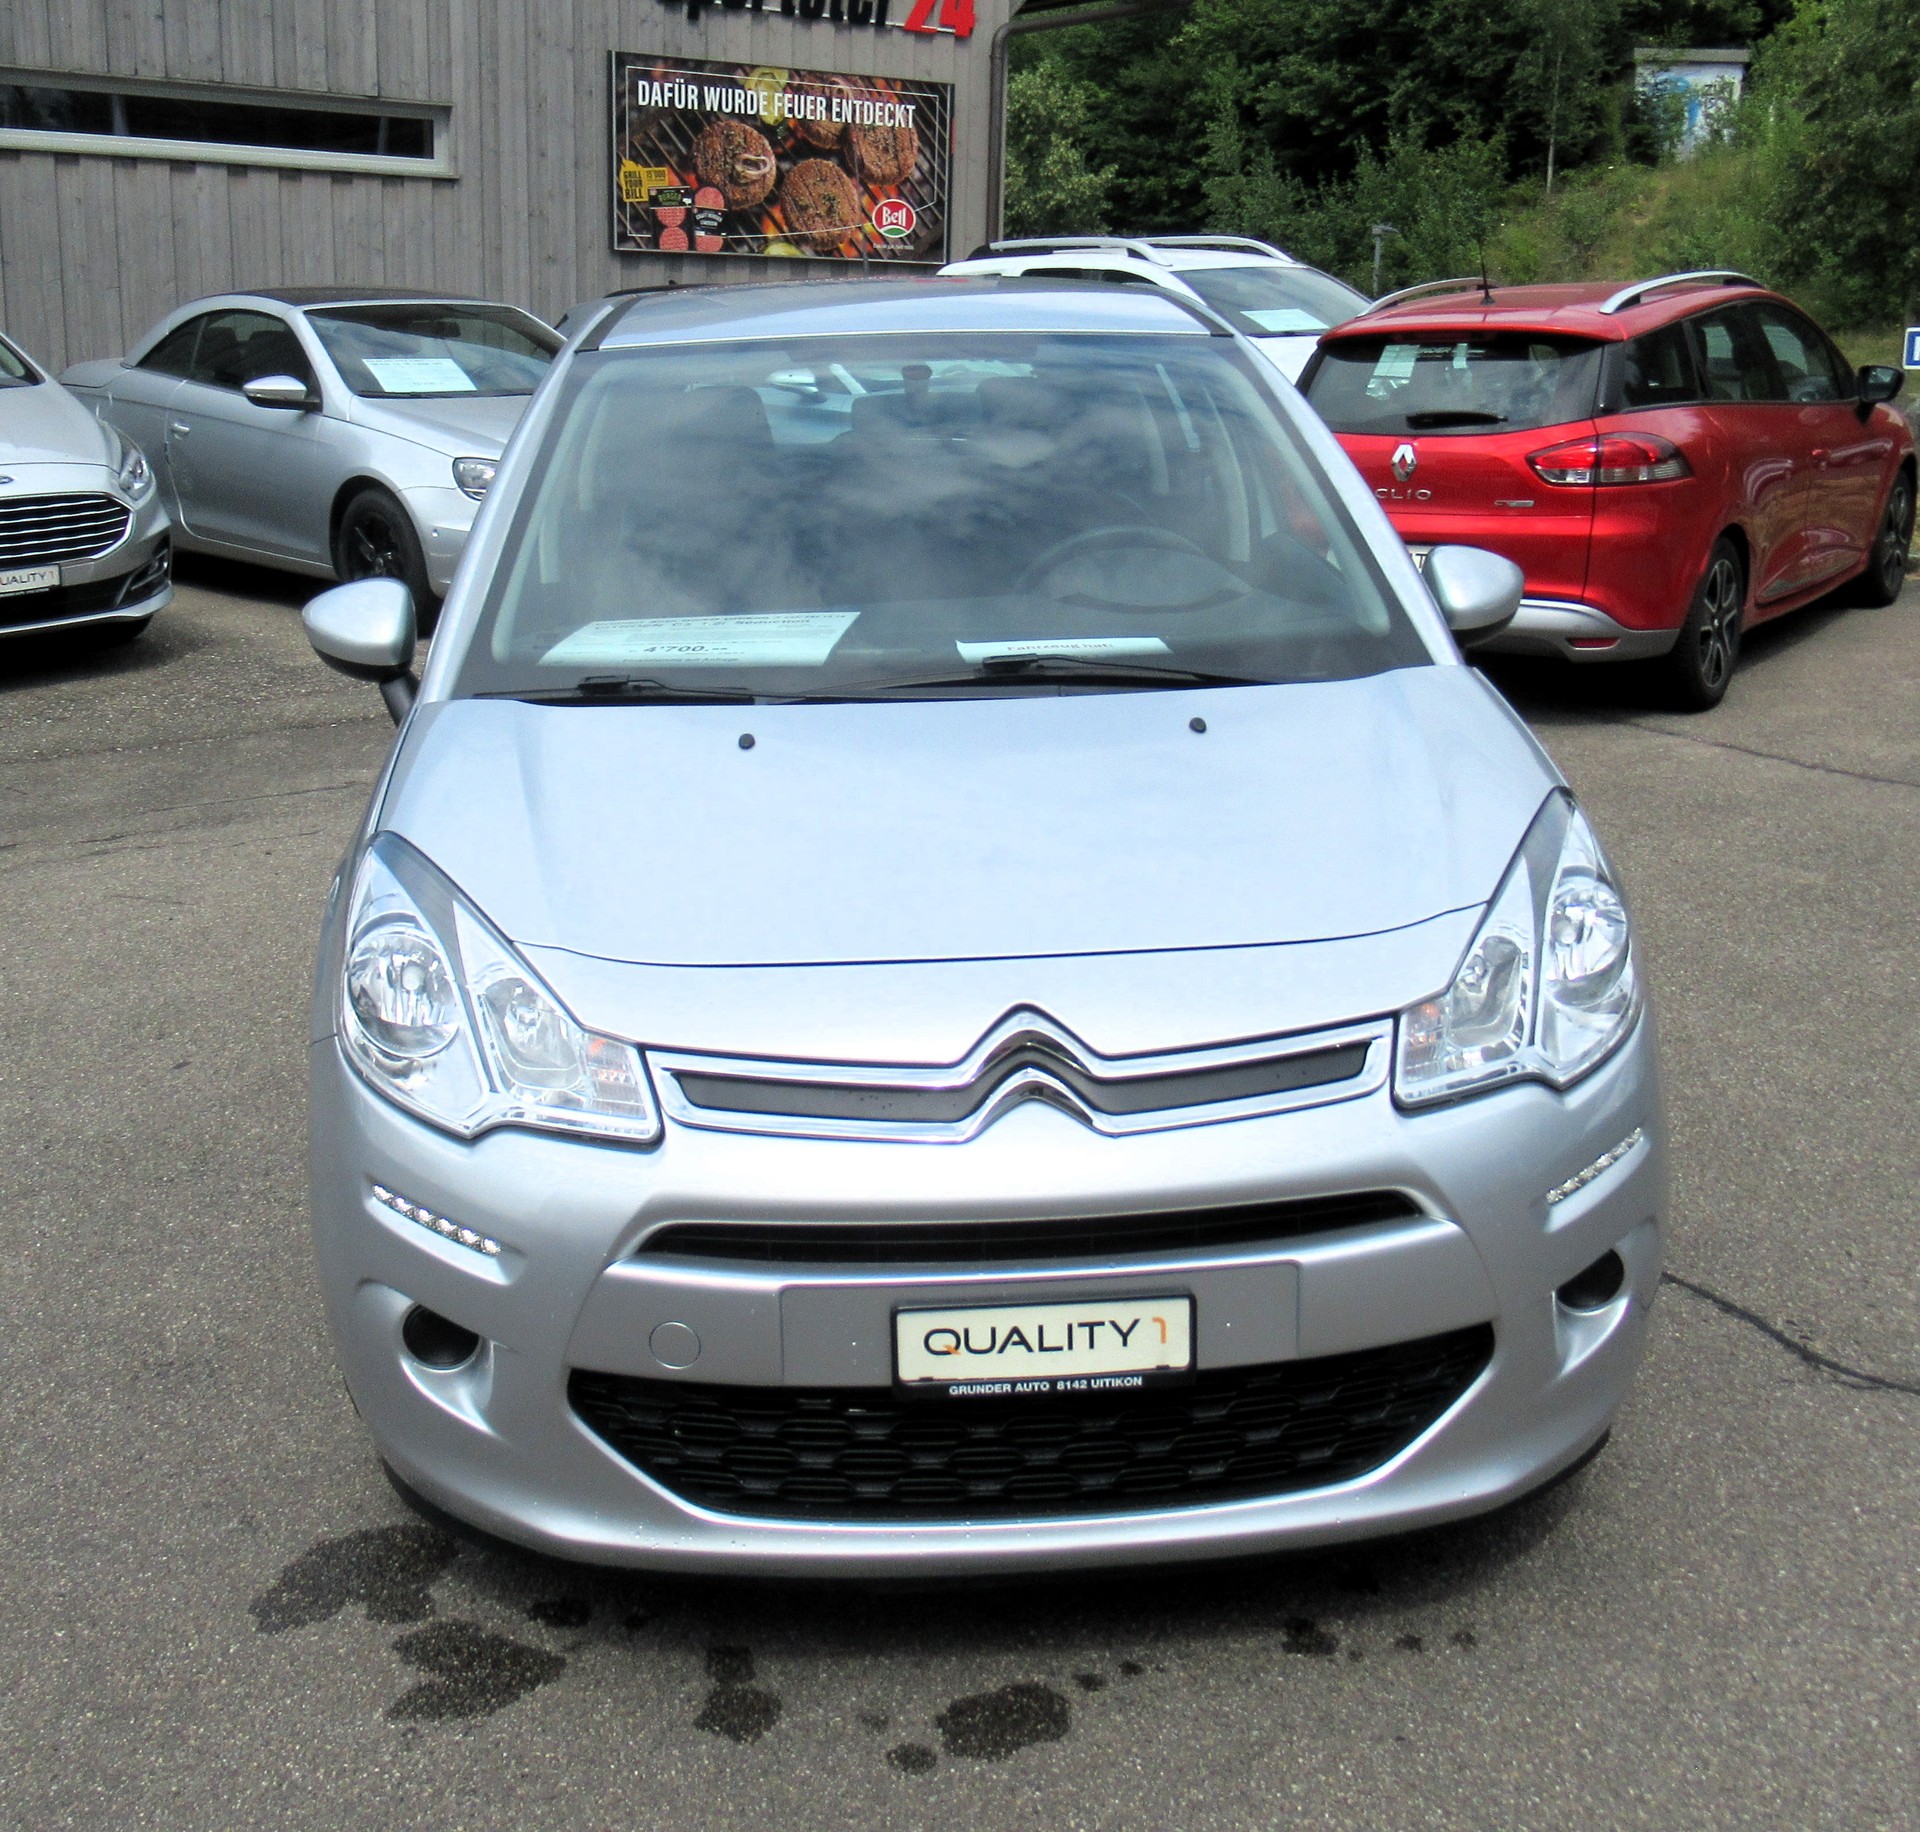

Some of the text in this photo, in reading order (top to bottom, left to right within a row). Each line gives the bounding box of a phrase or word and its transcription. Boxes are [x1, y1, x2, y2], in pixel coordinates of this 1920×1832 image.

[637, 78, 916, 128] DAFÜR WURDE FEUER ENTDECKT
[625, 188, 644, 199] BILL
[882, 206, 907, 227] Bell
[1375, 488, 1432, 500] CLIO
[0, 572, 46, 586] UALITY
[923, 1316, 1168, 1356] QUALITY 1
[949, 1376, 1143, 1396] GRUNDER AUTO 8142 UITIKON
